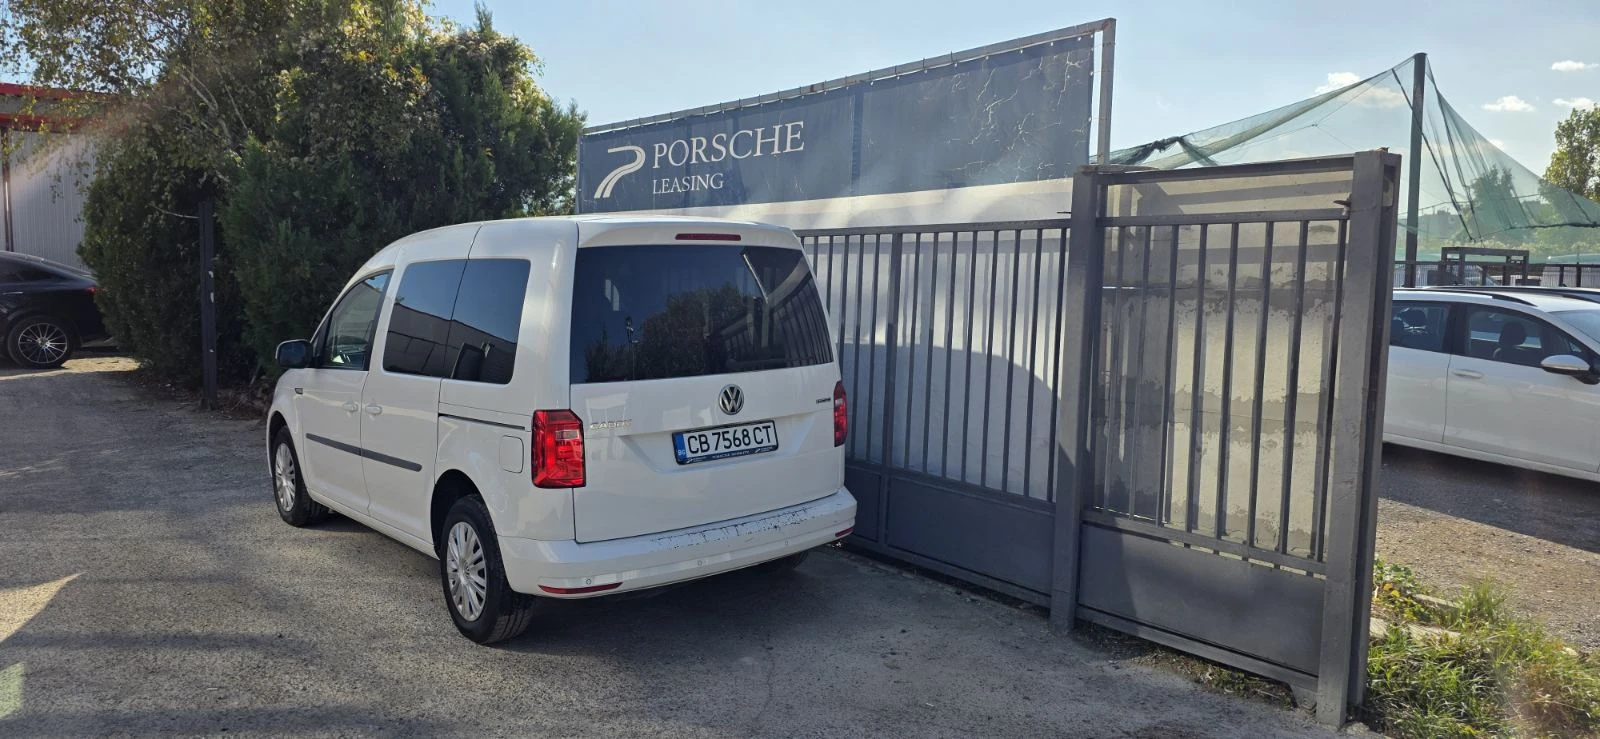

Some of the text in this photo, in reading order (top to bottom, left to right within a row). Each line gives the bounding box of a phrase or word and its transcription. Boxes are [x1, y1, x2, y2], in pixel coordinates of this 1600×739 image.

[652, 121, 805, 169] PORSCHE
[652, 173, 724, 195] LEASING
[687, 425, 772, 454] CB 7568 CT
